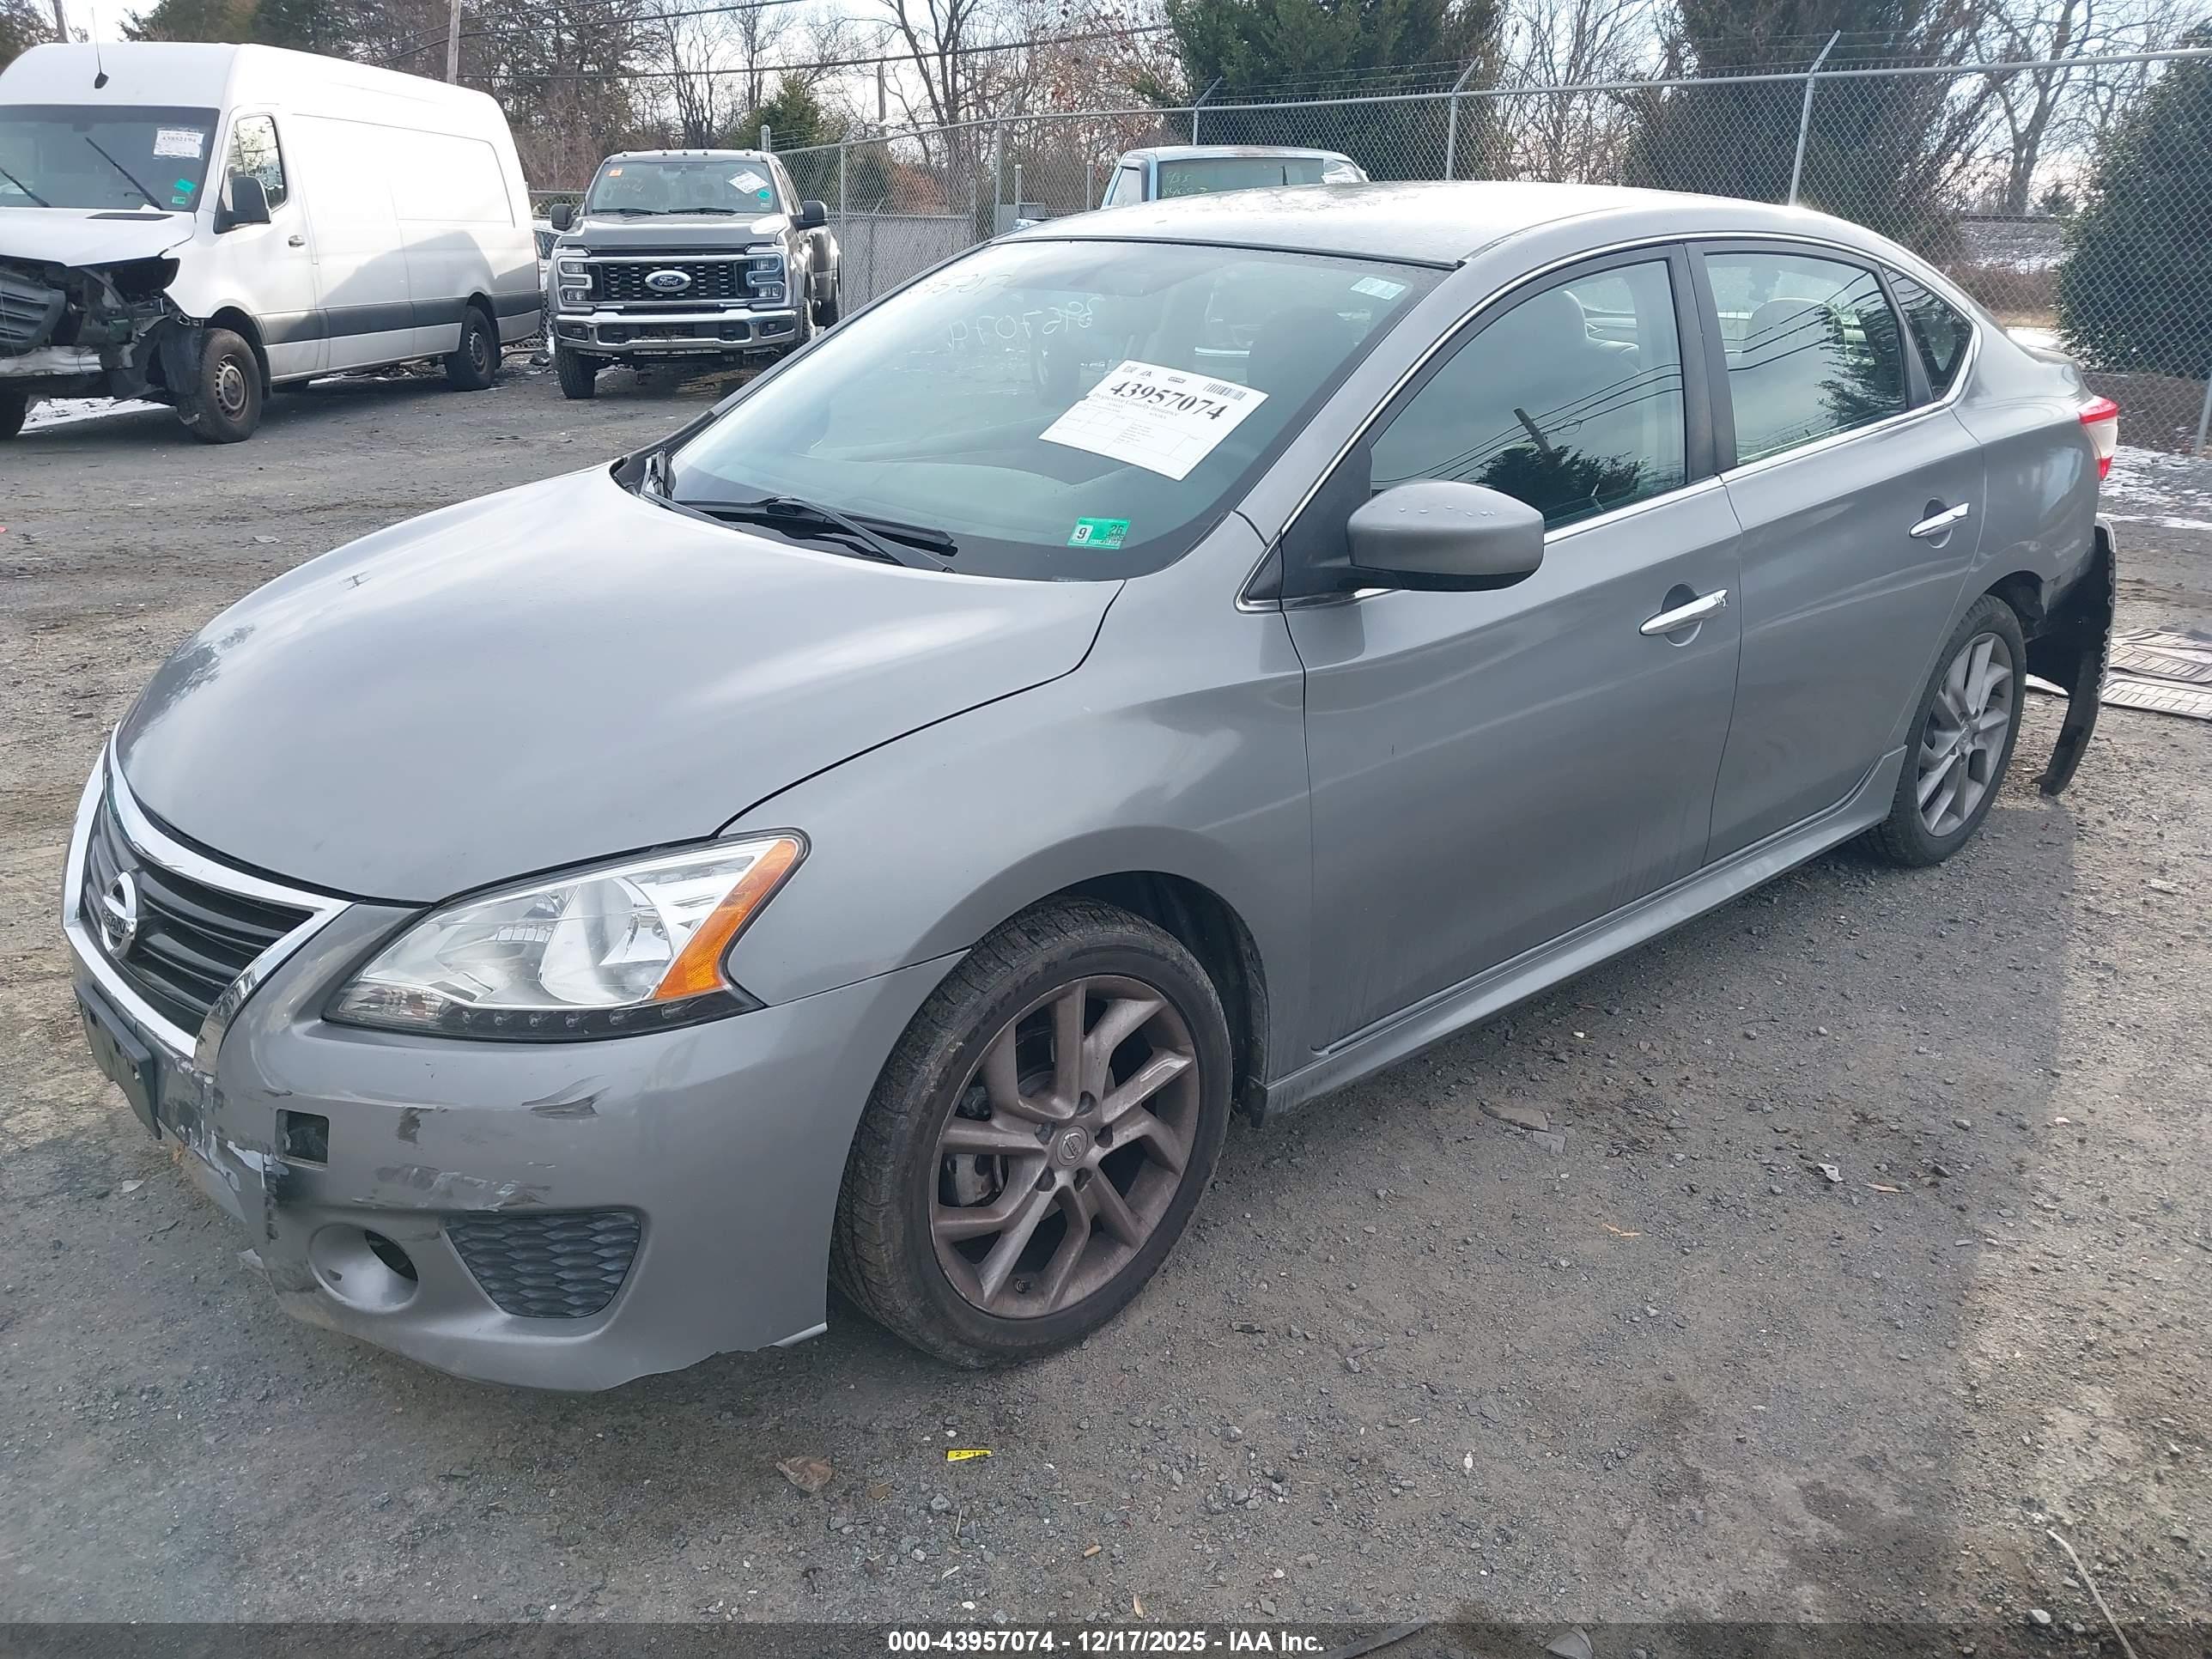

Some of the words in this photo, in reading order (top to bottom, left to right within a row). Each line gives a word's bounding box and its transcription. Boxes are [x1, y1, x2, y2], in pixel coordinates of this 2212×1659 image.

[658, 276, 678, 286] Ford
[1109, 380, 1228, 420] 43957074
[1077, 527, 1087, 539] 9
